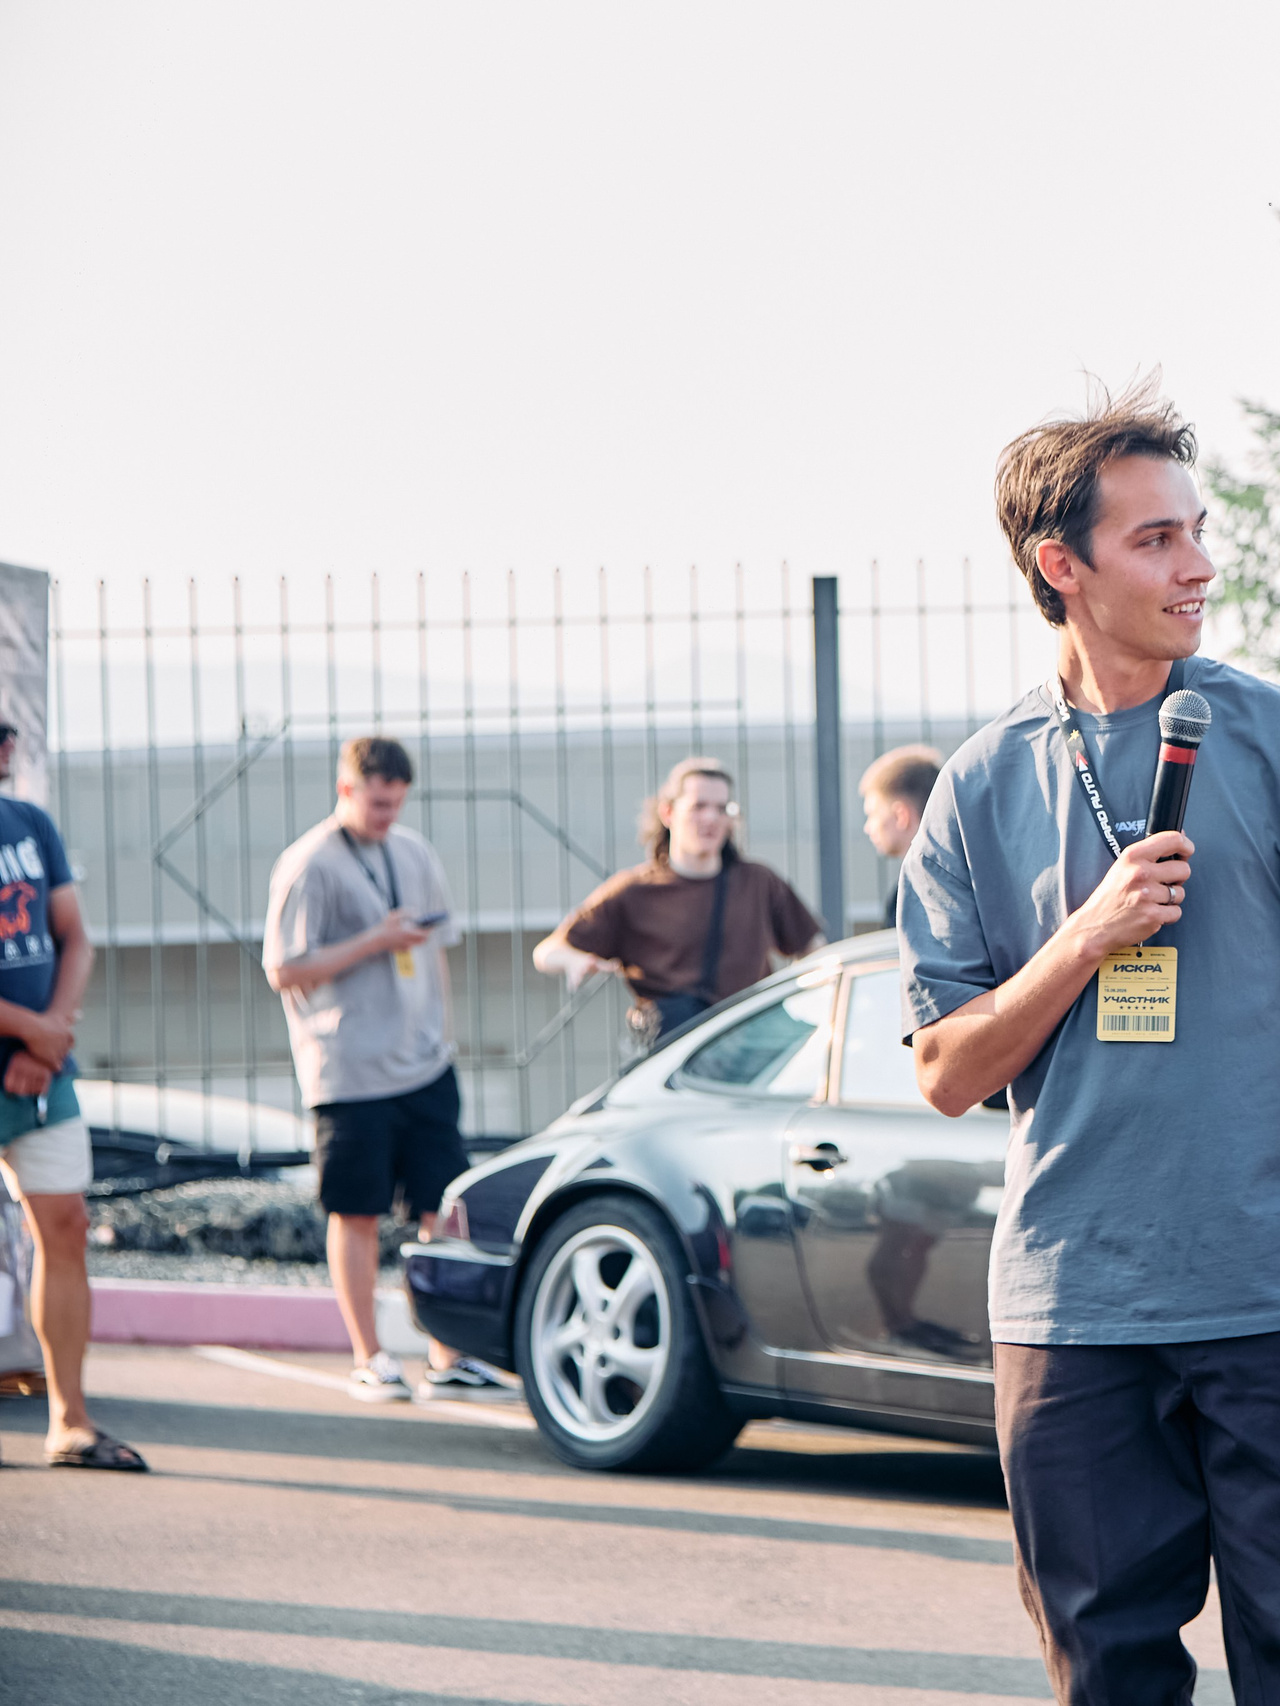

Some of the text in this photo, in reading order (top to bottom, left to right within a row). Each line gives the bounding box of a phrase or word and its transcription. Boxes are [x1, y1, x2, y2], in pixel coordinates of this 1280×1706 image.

[1080, 773, 1102, 809] AUTO
[1113, 963, 1162, 973] ИСКРА
[1103, 996, 1170, 1004] УЧАСТНИК
